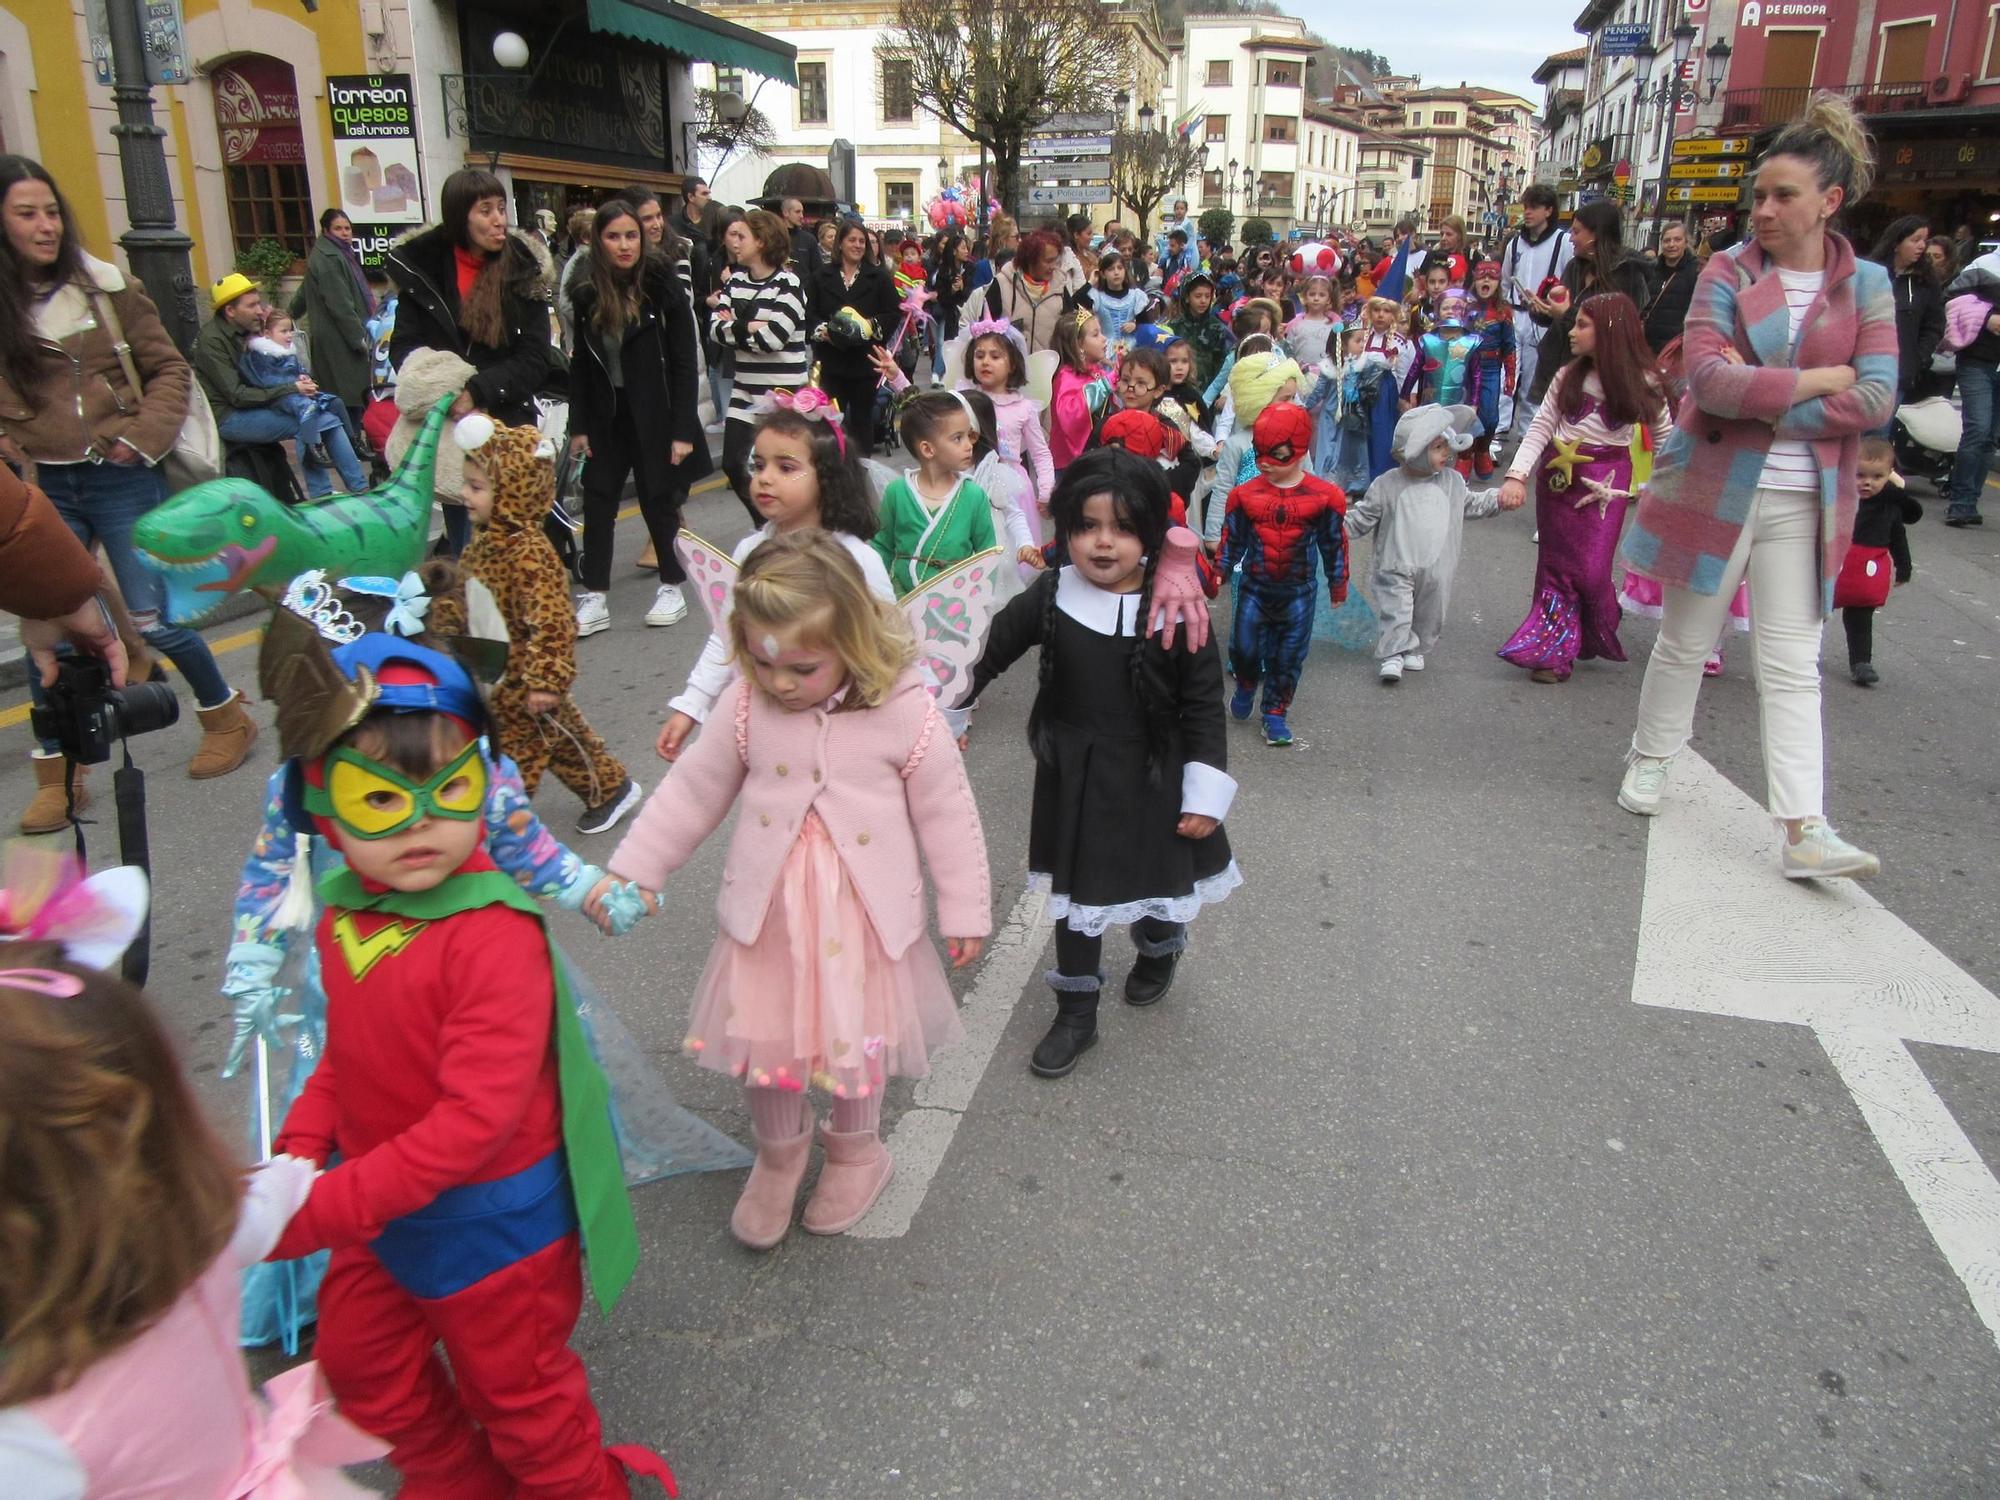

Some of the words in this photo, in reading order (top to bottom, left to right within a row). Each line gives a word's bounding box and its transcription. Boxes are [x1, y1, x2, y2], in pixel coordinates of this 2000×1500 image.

[1766, 5, 1780, 14] DE
[1782, 5, 1826, 14] EUROPA
[334, 107, 409, 136] quesos
[349, 122, 410, 136] asturianos
[1085, 189, 1107, 197] Local
